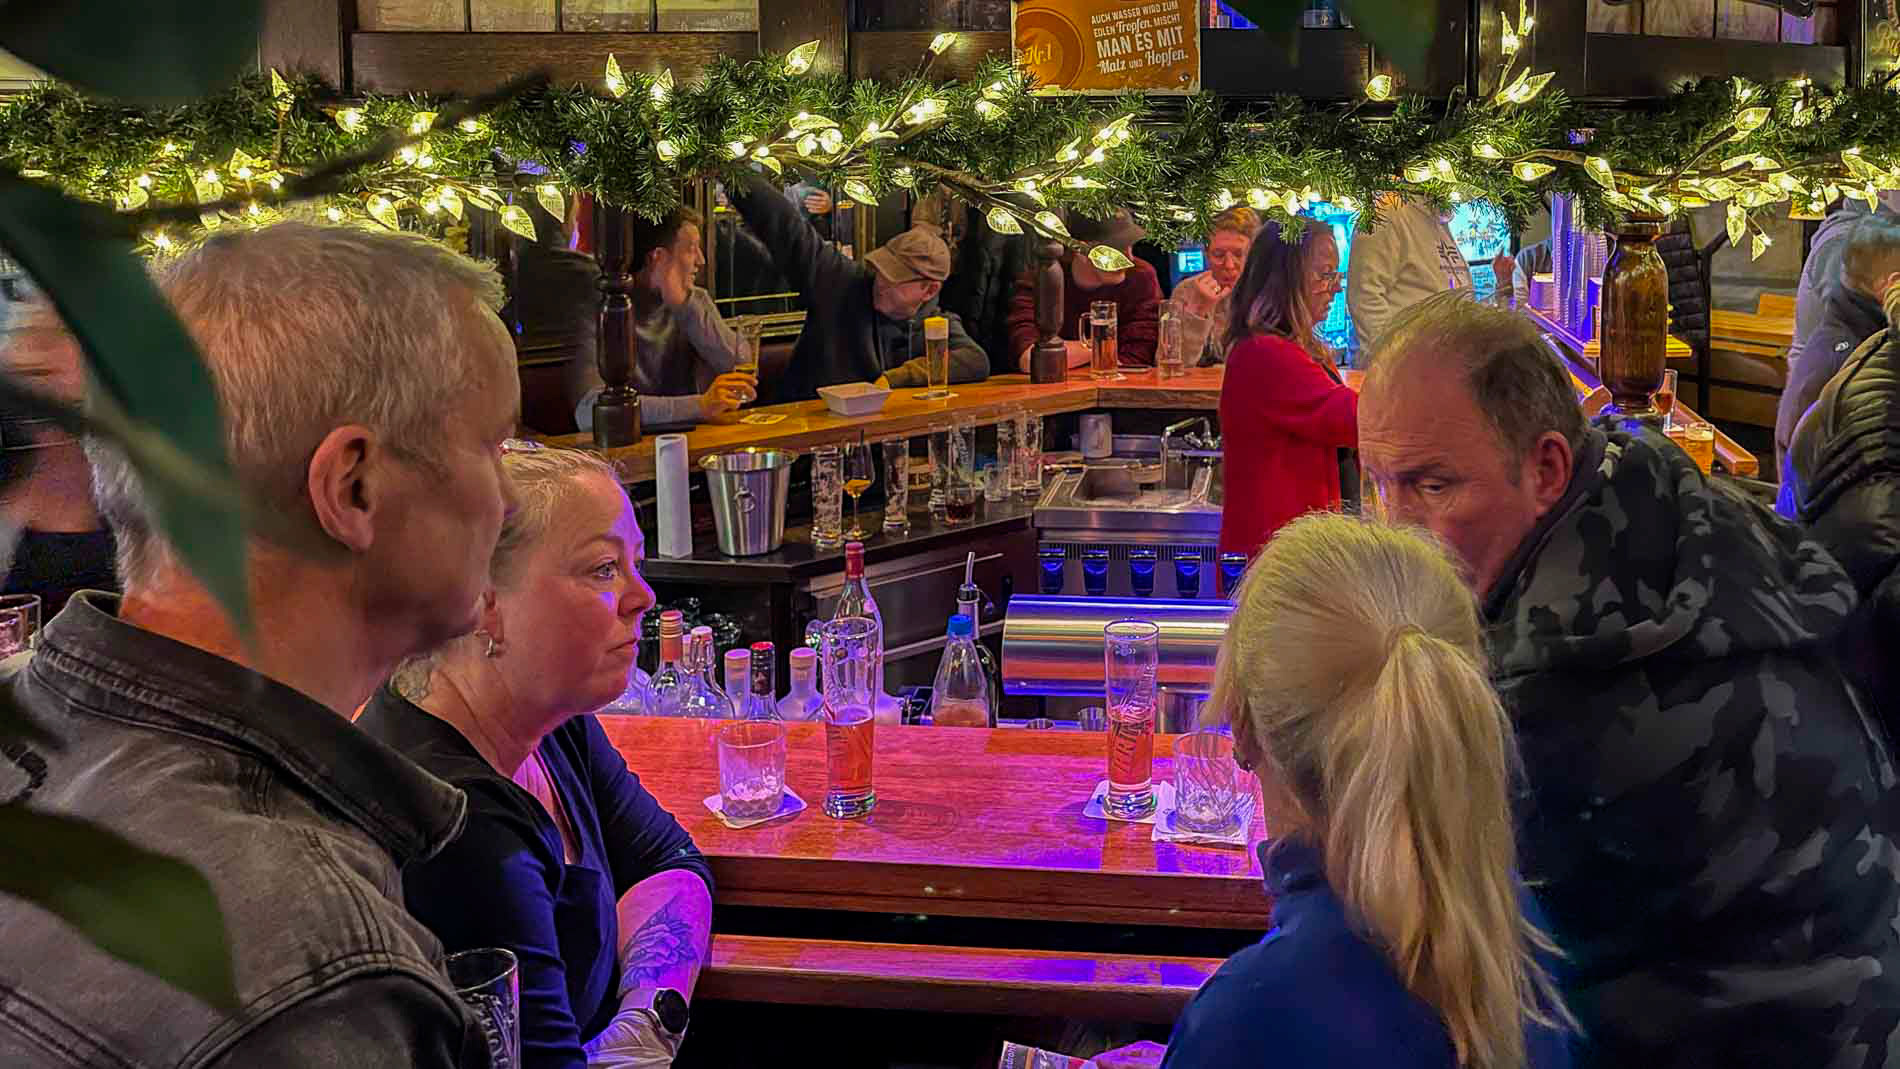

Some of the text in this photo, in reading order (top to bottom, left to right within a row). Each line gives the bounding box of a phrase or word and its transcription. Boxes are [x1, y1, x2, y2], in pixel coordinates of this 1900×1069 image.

[1092, 0, 1179, 25] AUCH WASSER WIRD ZUM
[1093, 26, 1116, 38] EDLEN
[1153, 13, 1180, 26] MISCHT
[1096, 26, 1184, 59] MAN ES MIT
[1097, 58, 1127, 74] Malz
